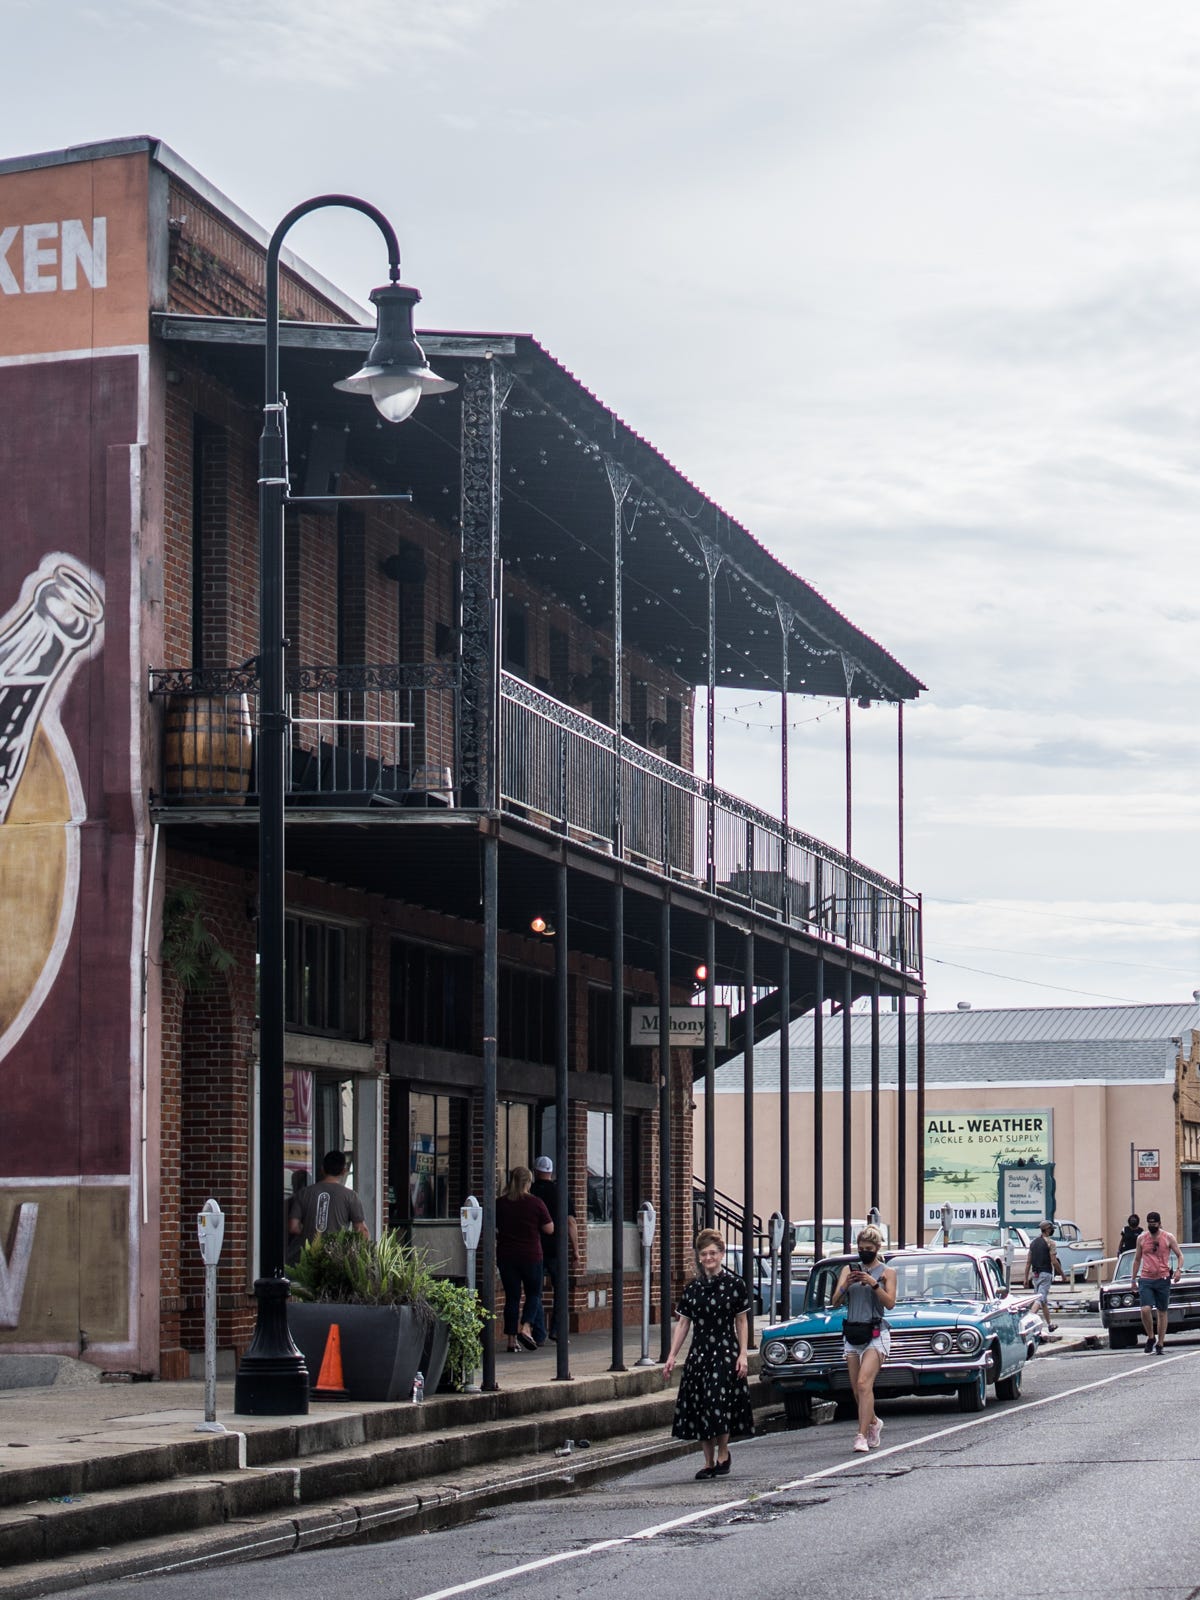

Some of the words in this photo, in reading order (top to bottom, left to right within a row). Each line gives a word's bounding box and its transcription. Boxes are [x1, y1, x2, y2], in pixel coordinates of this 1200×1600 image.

[927, 1120, 956, 1133] ALL
[967, 1118, 1043, 1132] WEATHER
[929, 1136, 963, 1144] TACKLE
[967, 1135, 974, 1143] &
[978, 1135, 1003, 1143] BOAT
[1006, 1134, 1040, 1143] SUPPLY
[929, 1209, 977, 1220] DOTOWN
